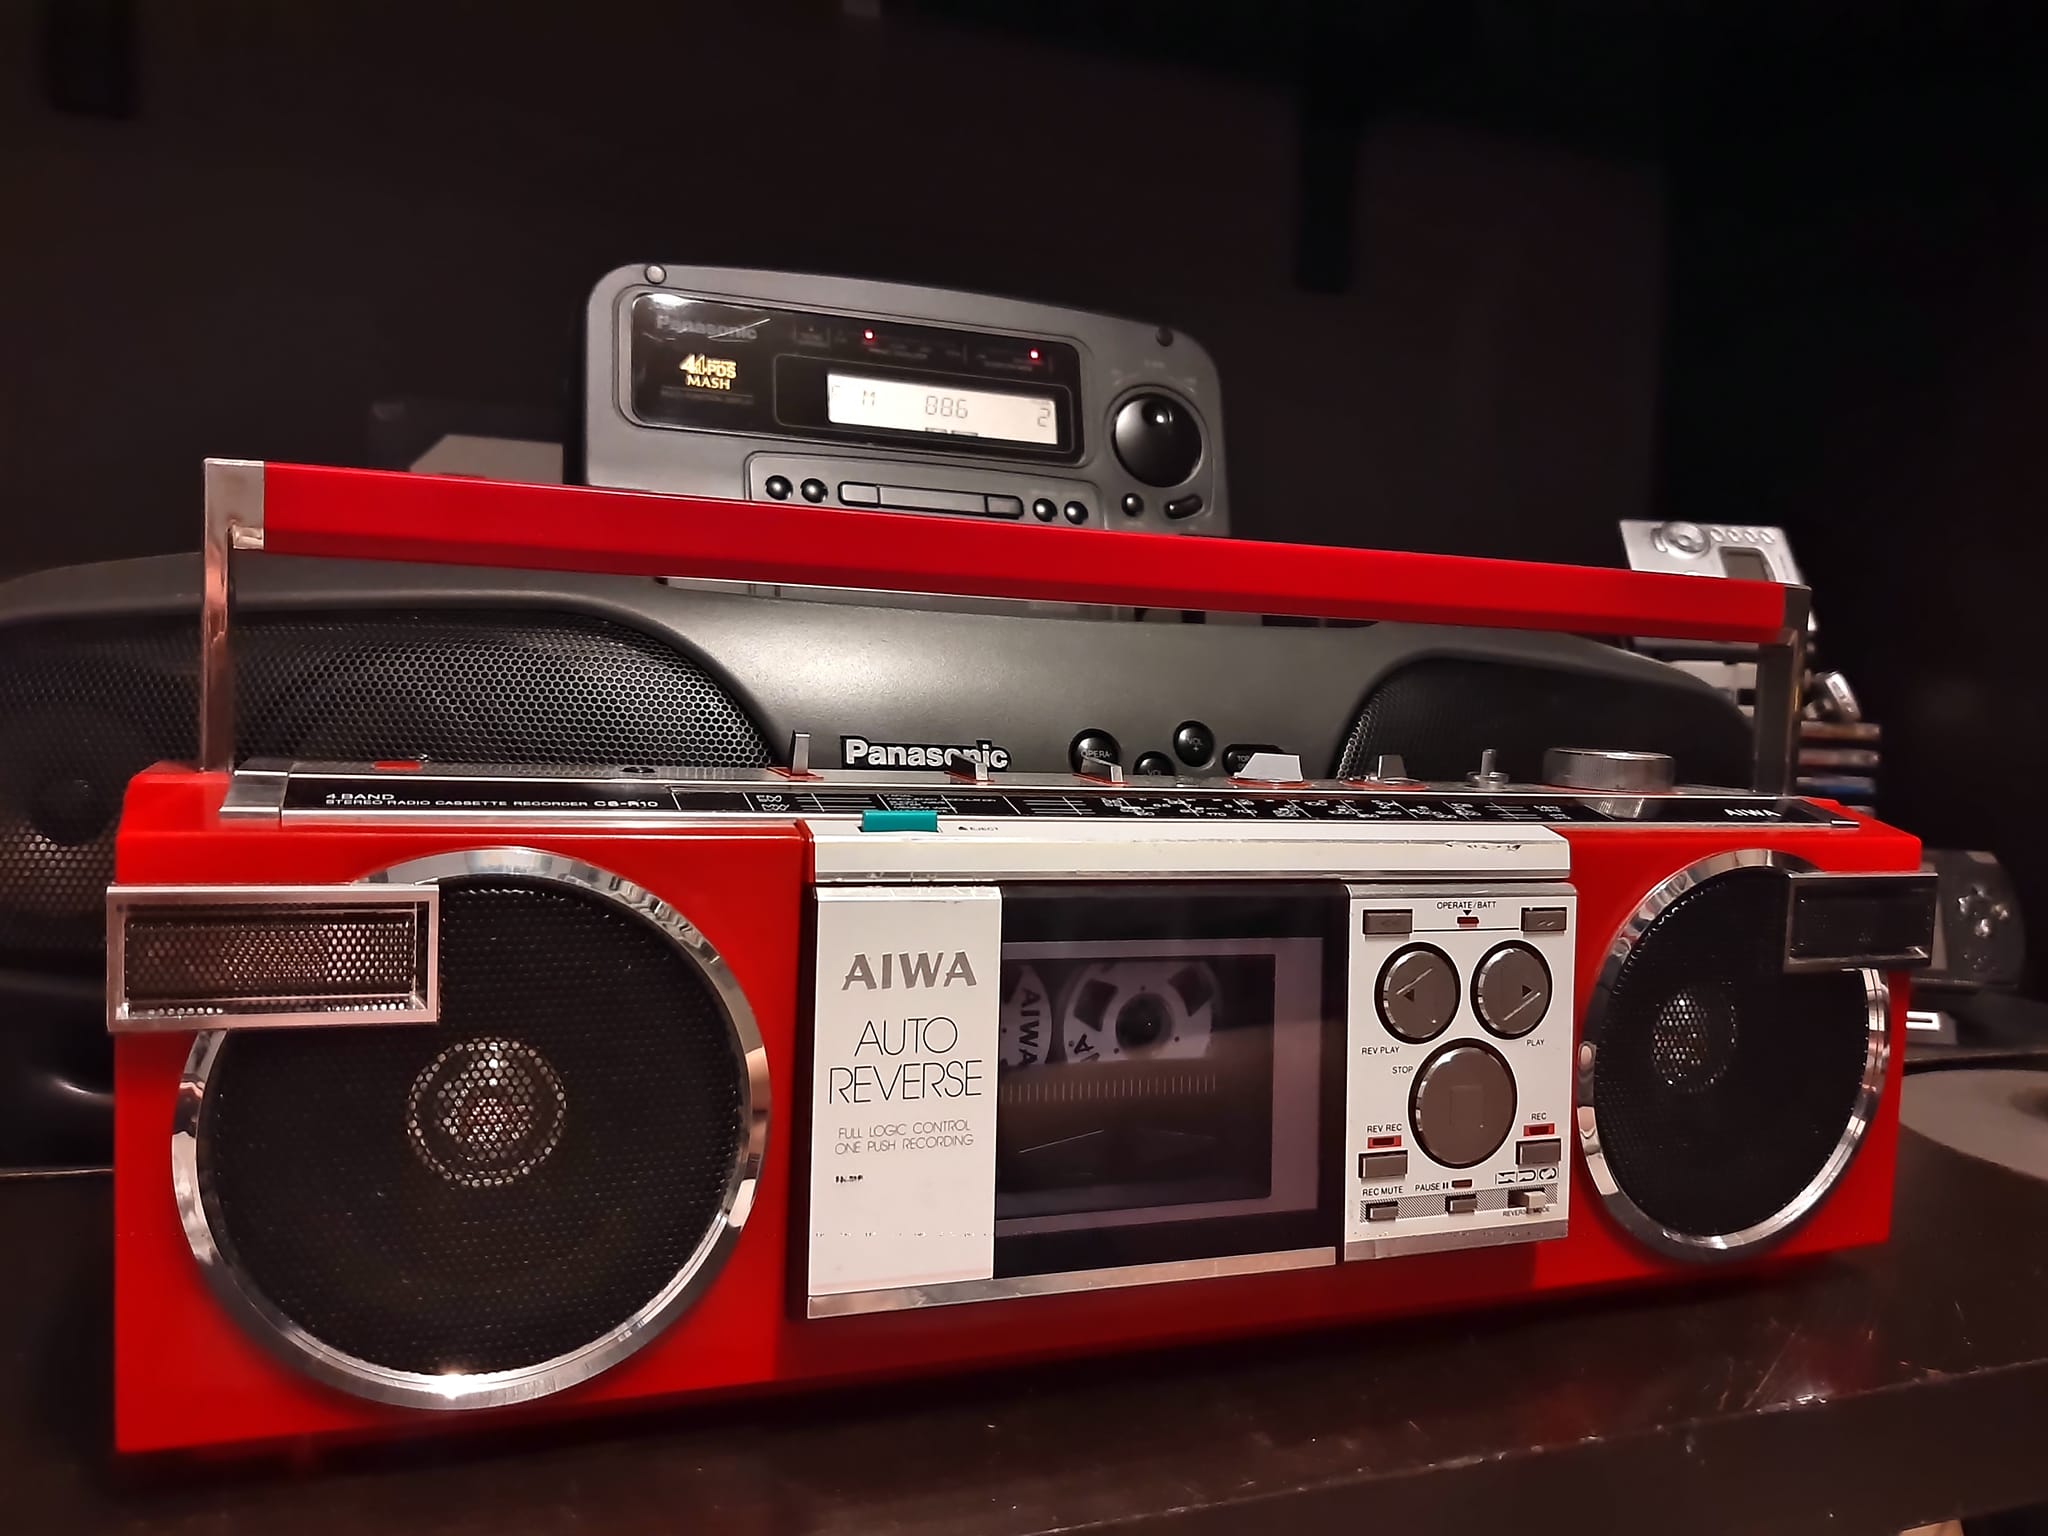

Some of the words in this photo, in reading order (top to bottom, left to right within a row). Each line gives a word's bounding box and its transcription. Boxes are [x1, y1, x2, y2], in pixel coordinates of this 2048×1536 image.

[656, 315, 758, 340] Panasonic
[686, 375, 731, 391] MASH
[1037, 407, 1052, 428] 2
[845, 739, 1009, 769] Panasonic
[1723, 808, 1782, 817] AIWA
[842, 951, 977, 991] AIWA
[855, 1017, 958, 1057] AUTO
[1526, 1039, 1545, 1047] PLAY
[1361, 1047, 1378, 1055] REV
[1380, 1046, 1400, 1055] PLAY
[1392, 1066, 1414, 1074] STOP
[829, 1060, 983, 1105] REVERSE
[1531, 1112, 1547, 1120] REC
[838, 1127, 862, 1140] FULL
[869, 1123, 907, 1138] LOGIC
[912, 1120, 971, 1135] CONTROL
[1367, 1125, 1383, 1133] REV
[1385, 1123, 1403, 1132] REC
[835, 1142, 861, 1155] ONE
[868, 1139, 896, 1152] PUSH
[902, 1134, 974, 1150] RECORDING
[1362, 1187, 1379, 1196] REC
[1381, 1186, 1404, 1195] MUTE
[1414, 1183, 1440, 1192] PAUSE
